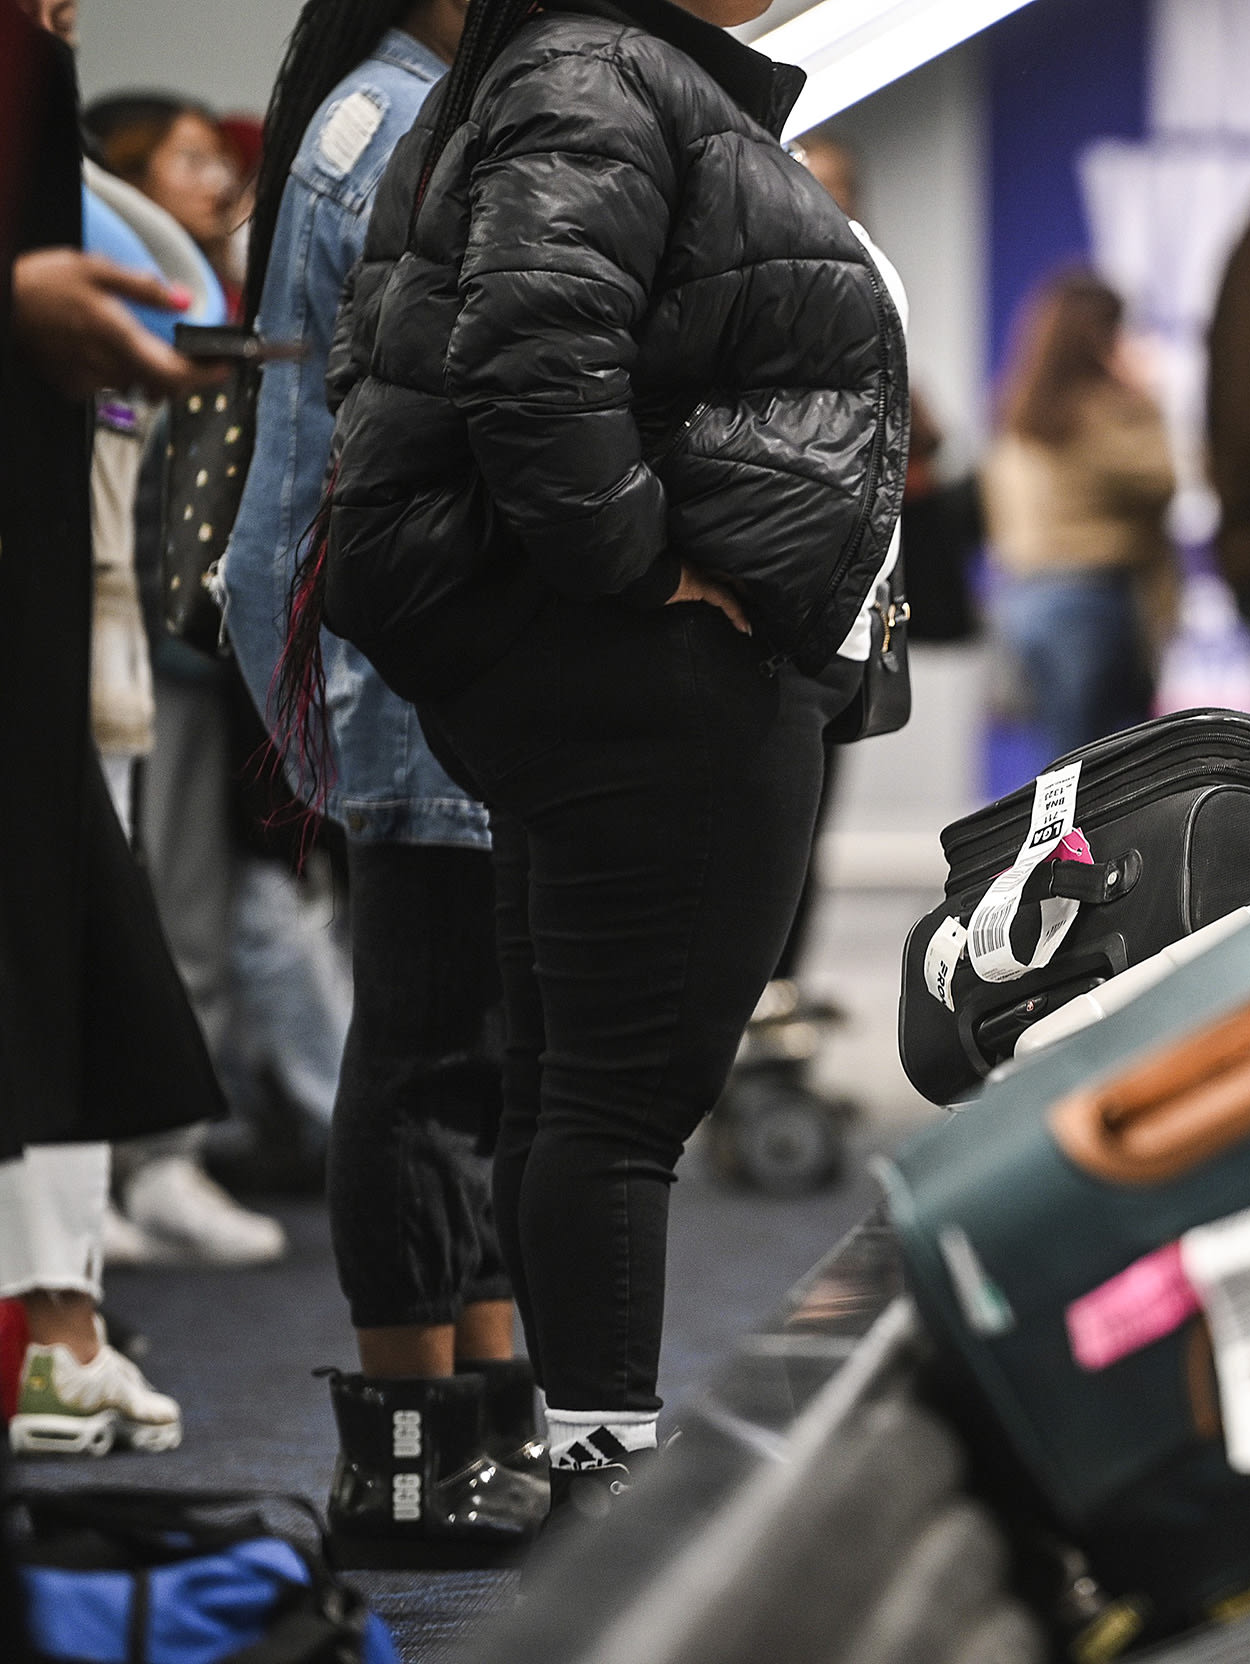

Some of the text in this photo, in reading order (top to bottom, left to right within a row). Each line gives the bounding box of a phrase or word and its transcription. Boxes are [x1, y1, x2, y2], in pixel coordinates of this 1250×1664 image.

[1033, 821, 1062, 845] LGA
[392, 1409, 422, 1521] UGG UGG
